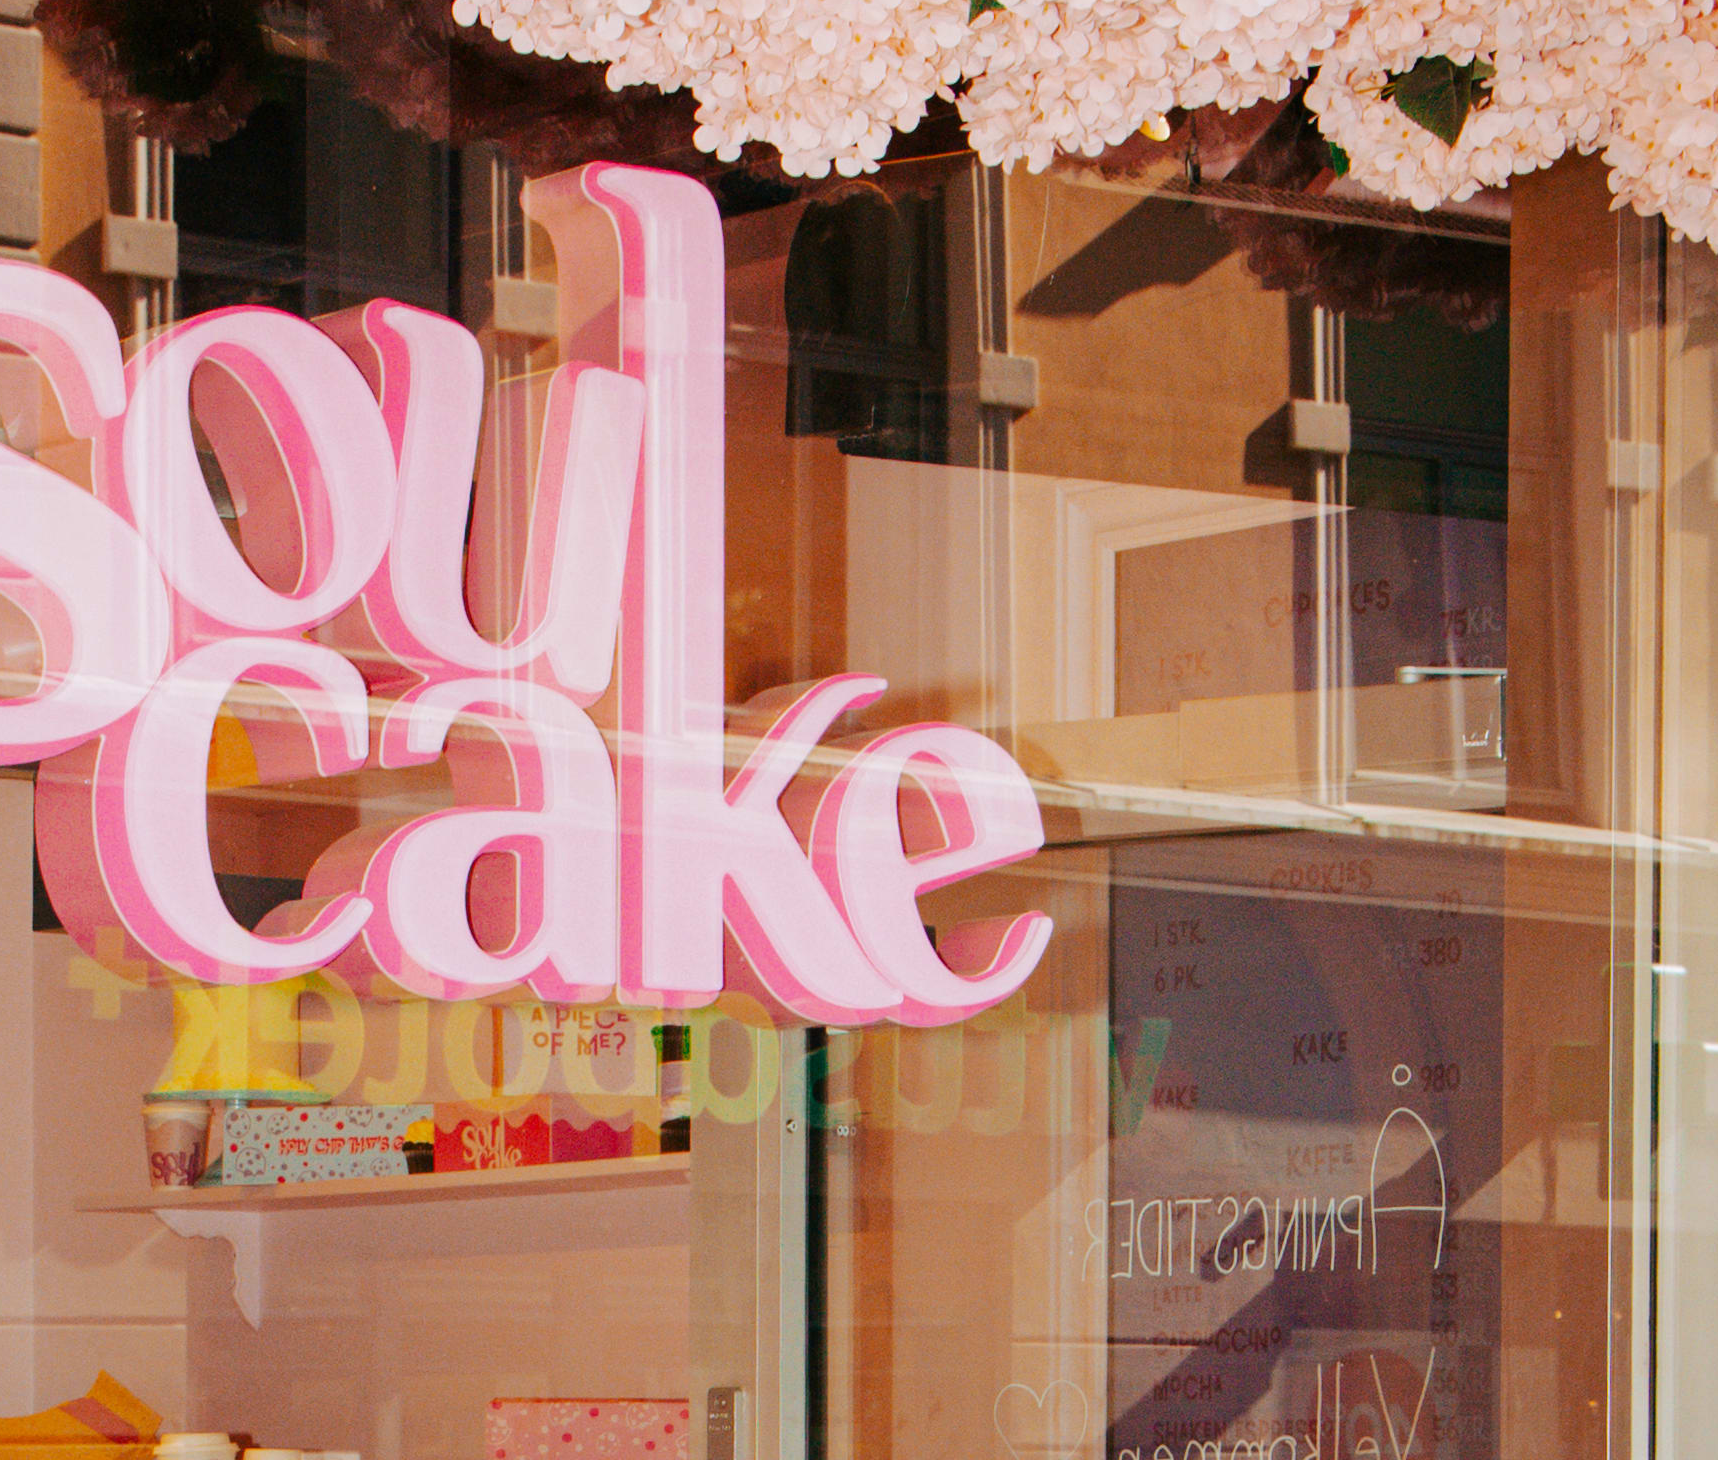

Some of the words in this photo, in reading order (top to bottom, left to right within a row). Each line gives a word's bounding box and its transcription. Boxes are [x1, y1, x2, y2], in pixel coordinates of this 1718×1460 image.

[532, 1031, 563, 1056] OF
[577, 1032, 627, 1057] ME?
[1292, 1031, 1348, 1065] KAKE
